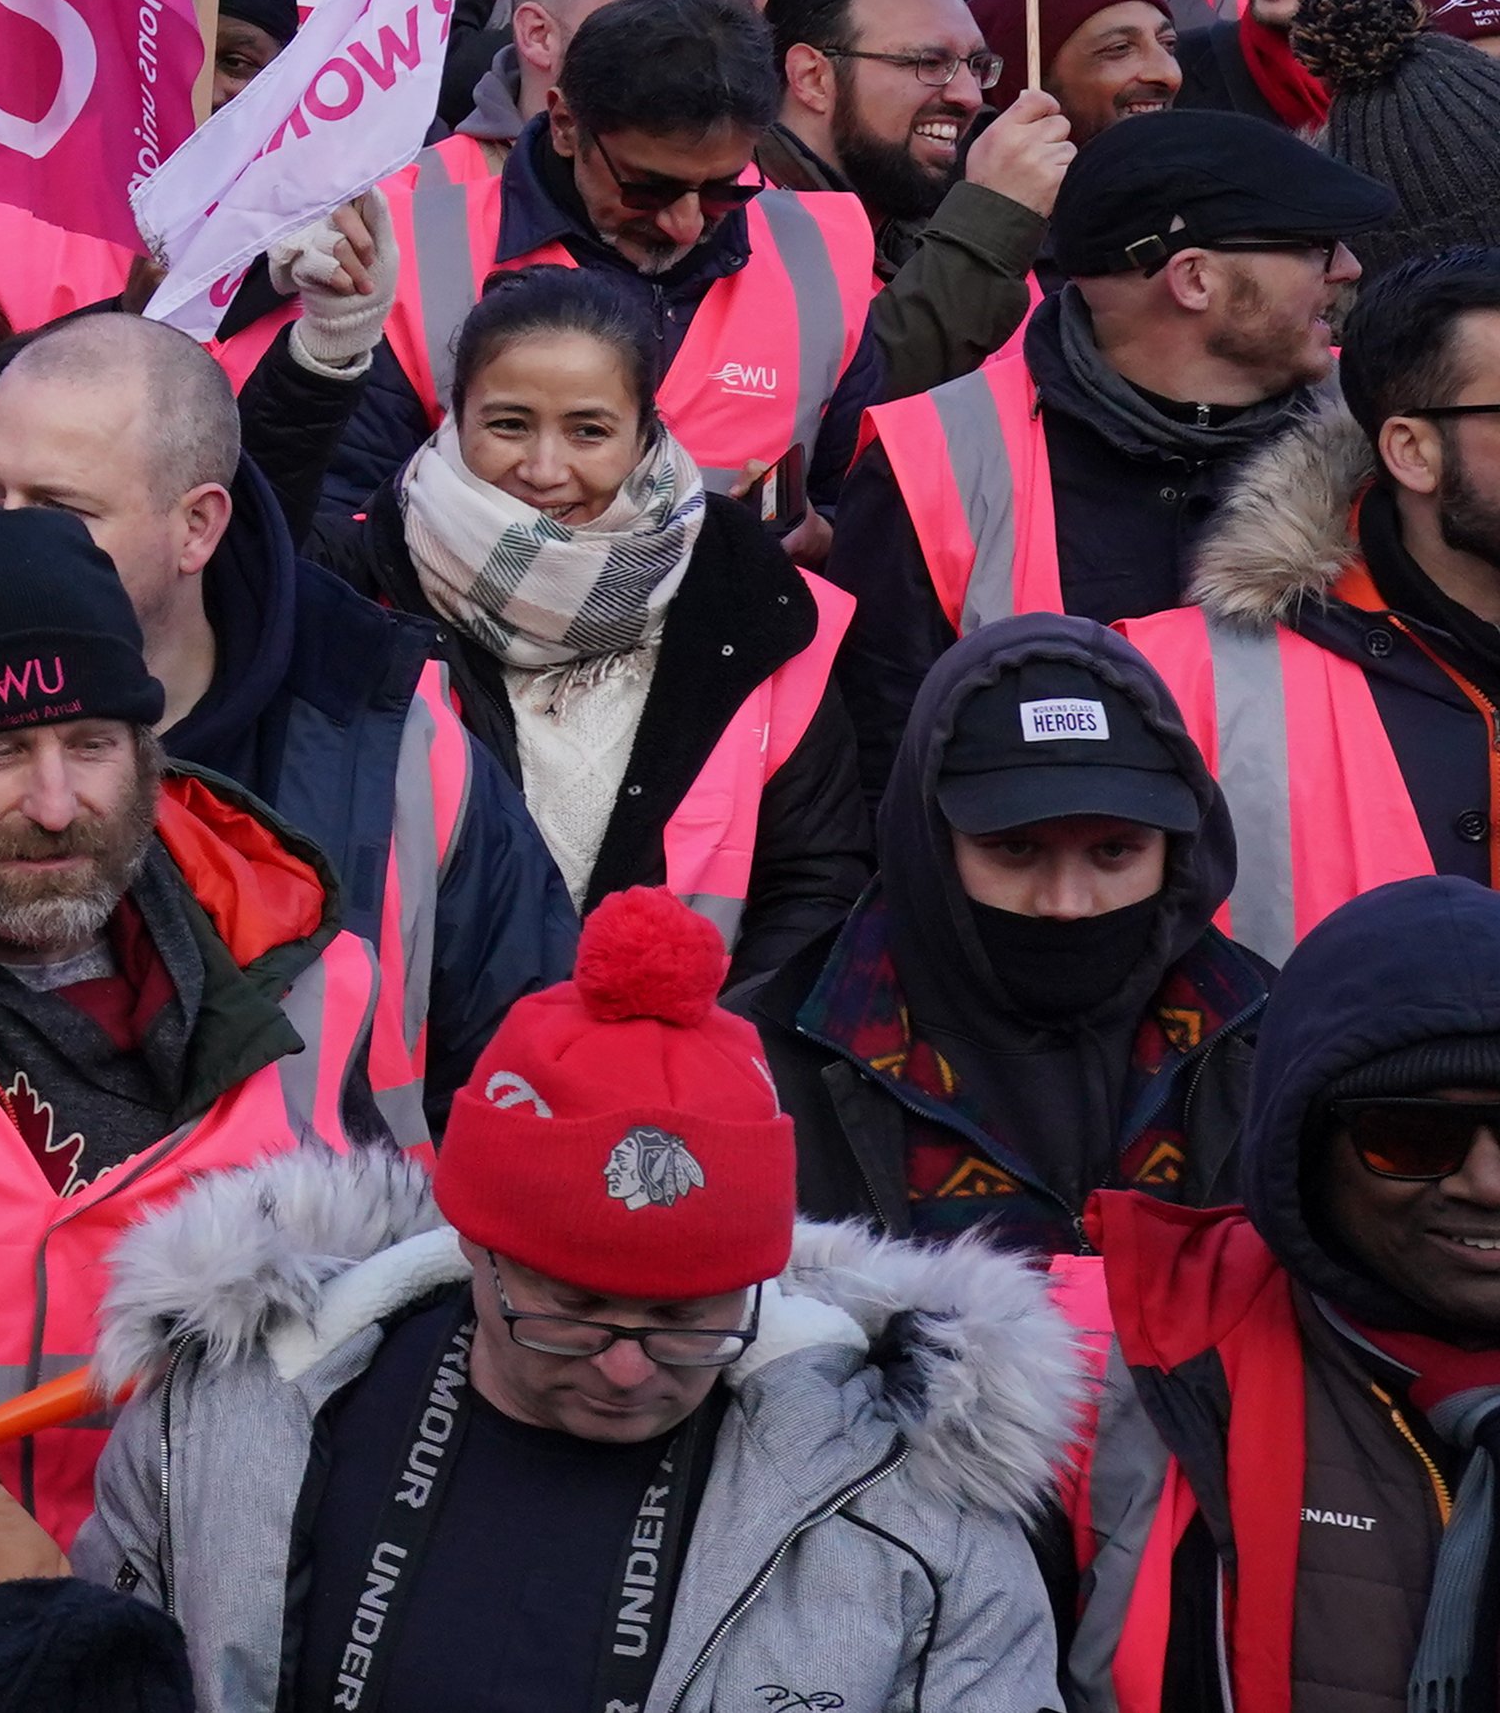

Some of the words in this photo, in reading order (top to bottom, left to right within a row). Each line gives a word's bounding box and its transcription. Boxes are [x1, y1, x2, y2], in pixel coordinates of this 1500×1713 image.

[723, 358, 777, 389] CWU
[1033, 705, 1067, 714] WORKING
[1034, 713, 1097, 732] HEROES
[613, 1485, 670, 1658] UNDER
[334, 1541, 408, 1712] UNDER
